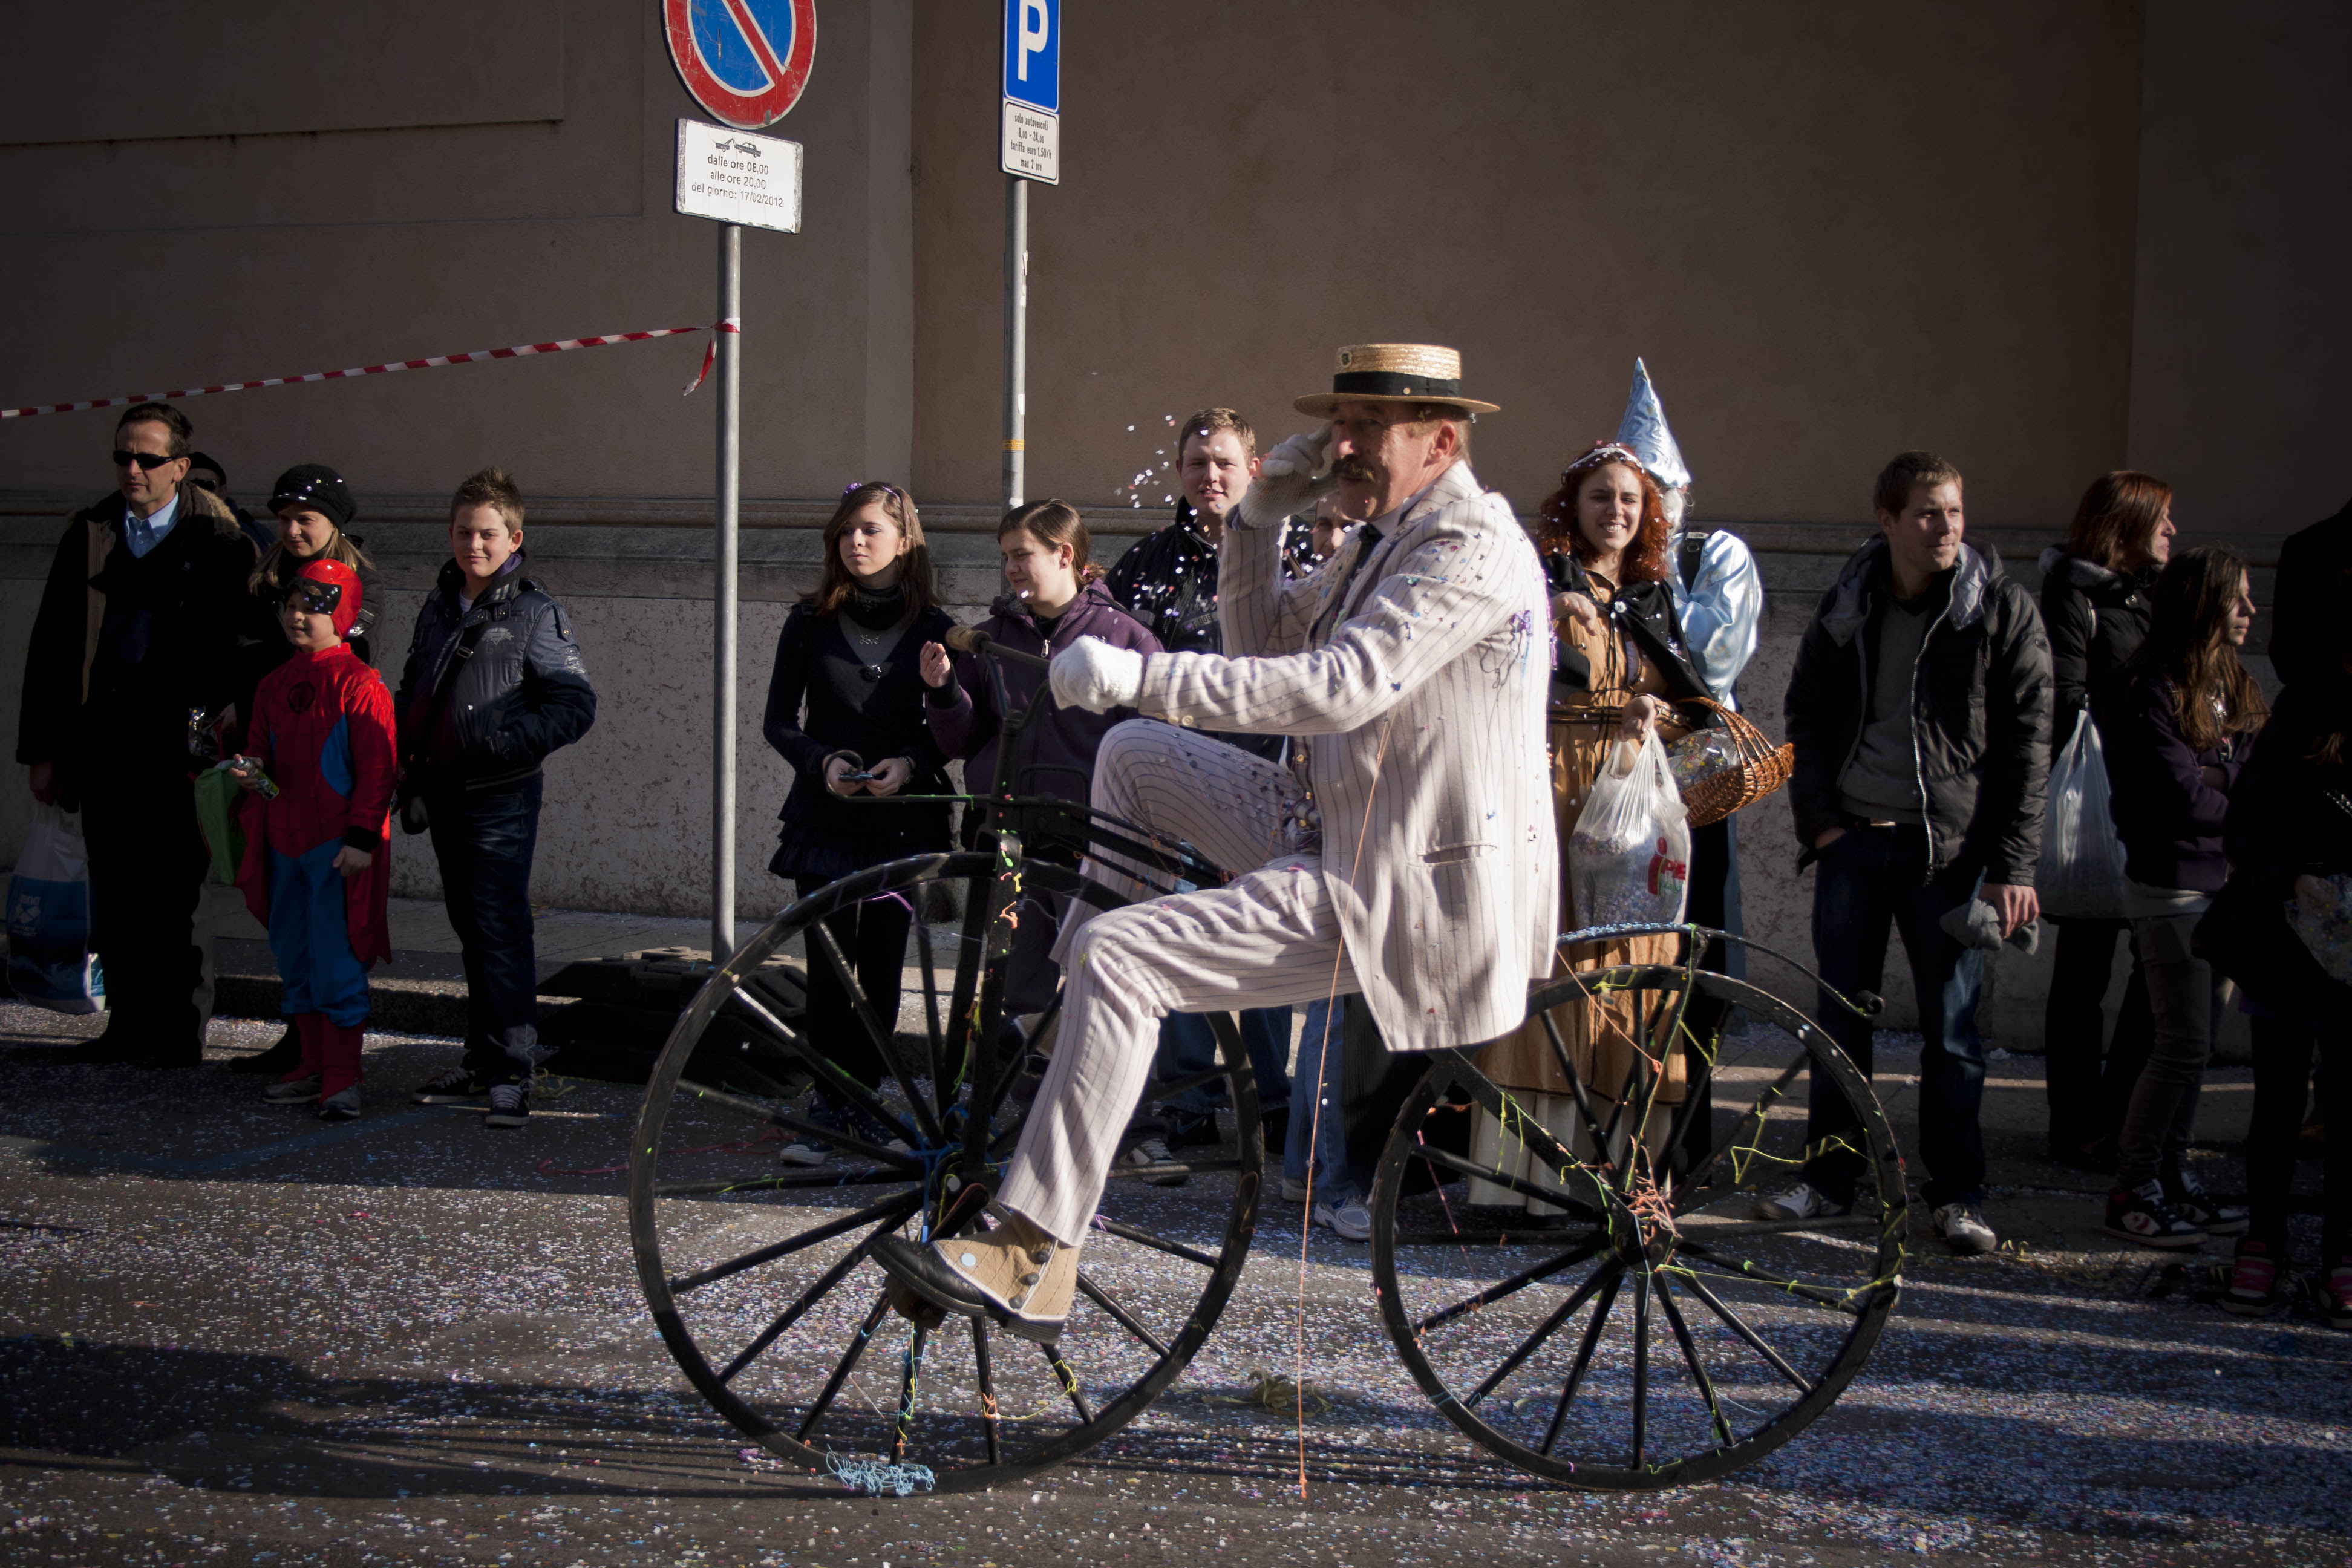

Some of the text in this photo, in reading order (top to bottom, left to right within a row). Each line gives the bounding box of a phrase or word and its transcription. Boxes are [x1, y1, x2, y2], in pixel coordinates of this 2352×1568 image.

[1018, 0, 1049, 82] P
[1015, 113, 1048, 131] solo autoveicoli
[1011, 140, 1025, 152] tariffa
[1027, 146, 1036, 156] euro
[707, 154, 728, 167] dalle
[731, 161, 744, 170] ore
[1021, 159, 1029, 169] max
[1031, 159, 1034, 169] 2
[711, 170, 725, 181] alle
[727, 175, 741, 185] ore
[691, 181, 783, 207] del giorno: 17/02/2012
